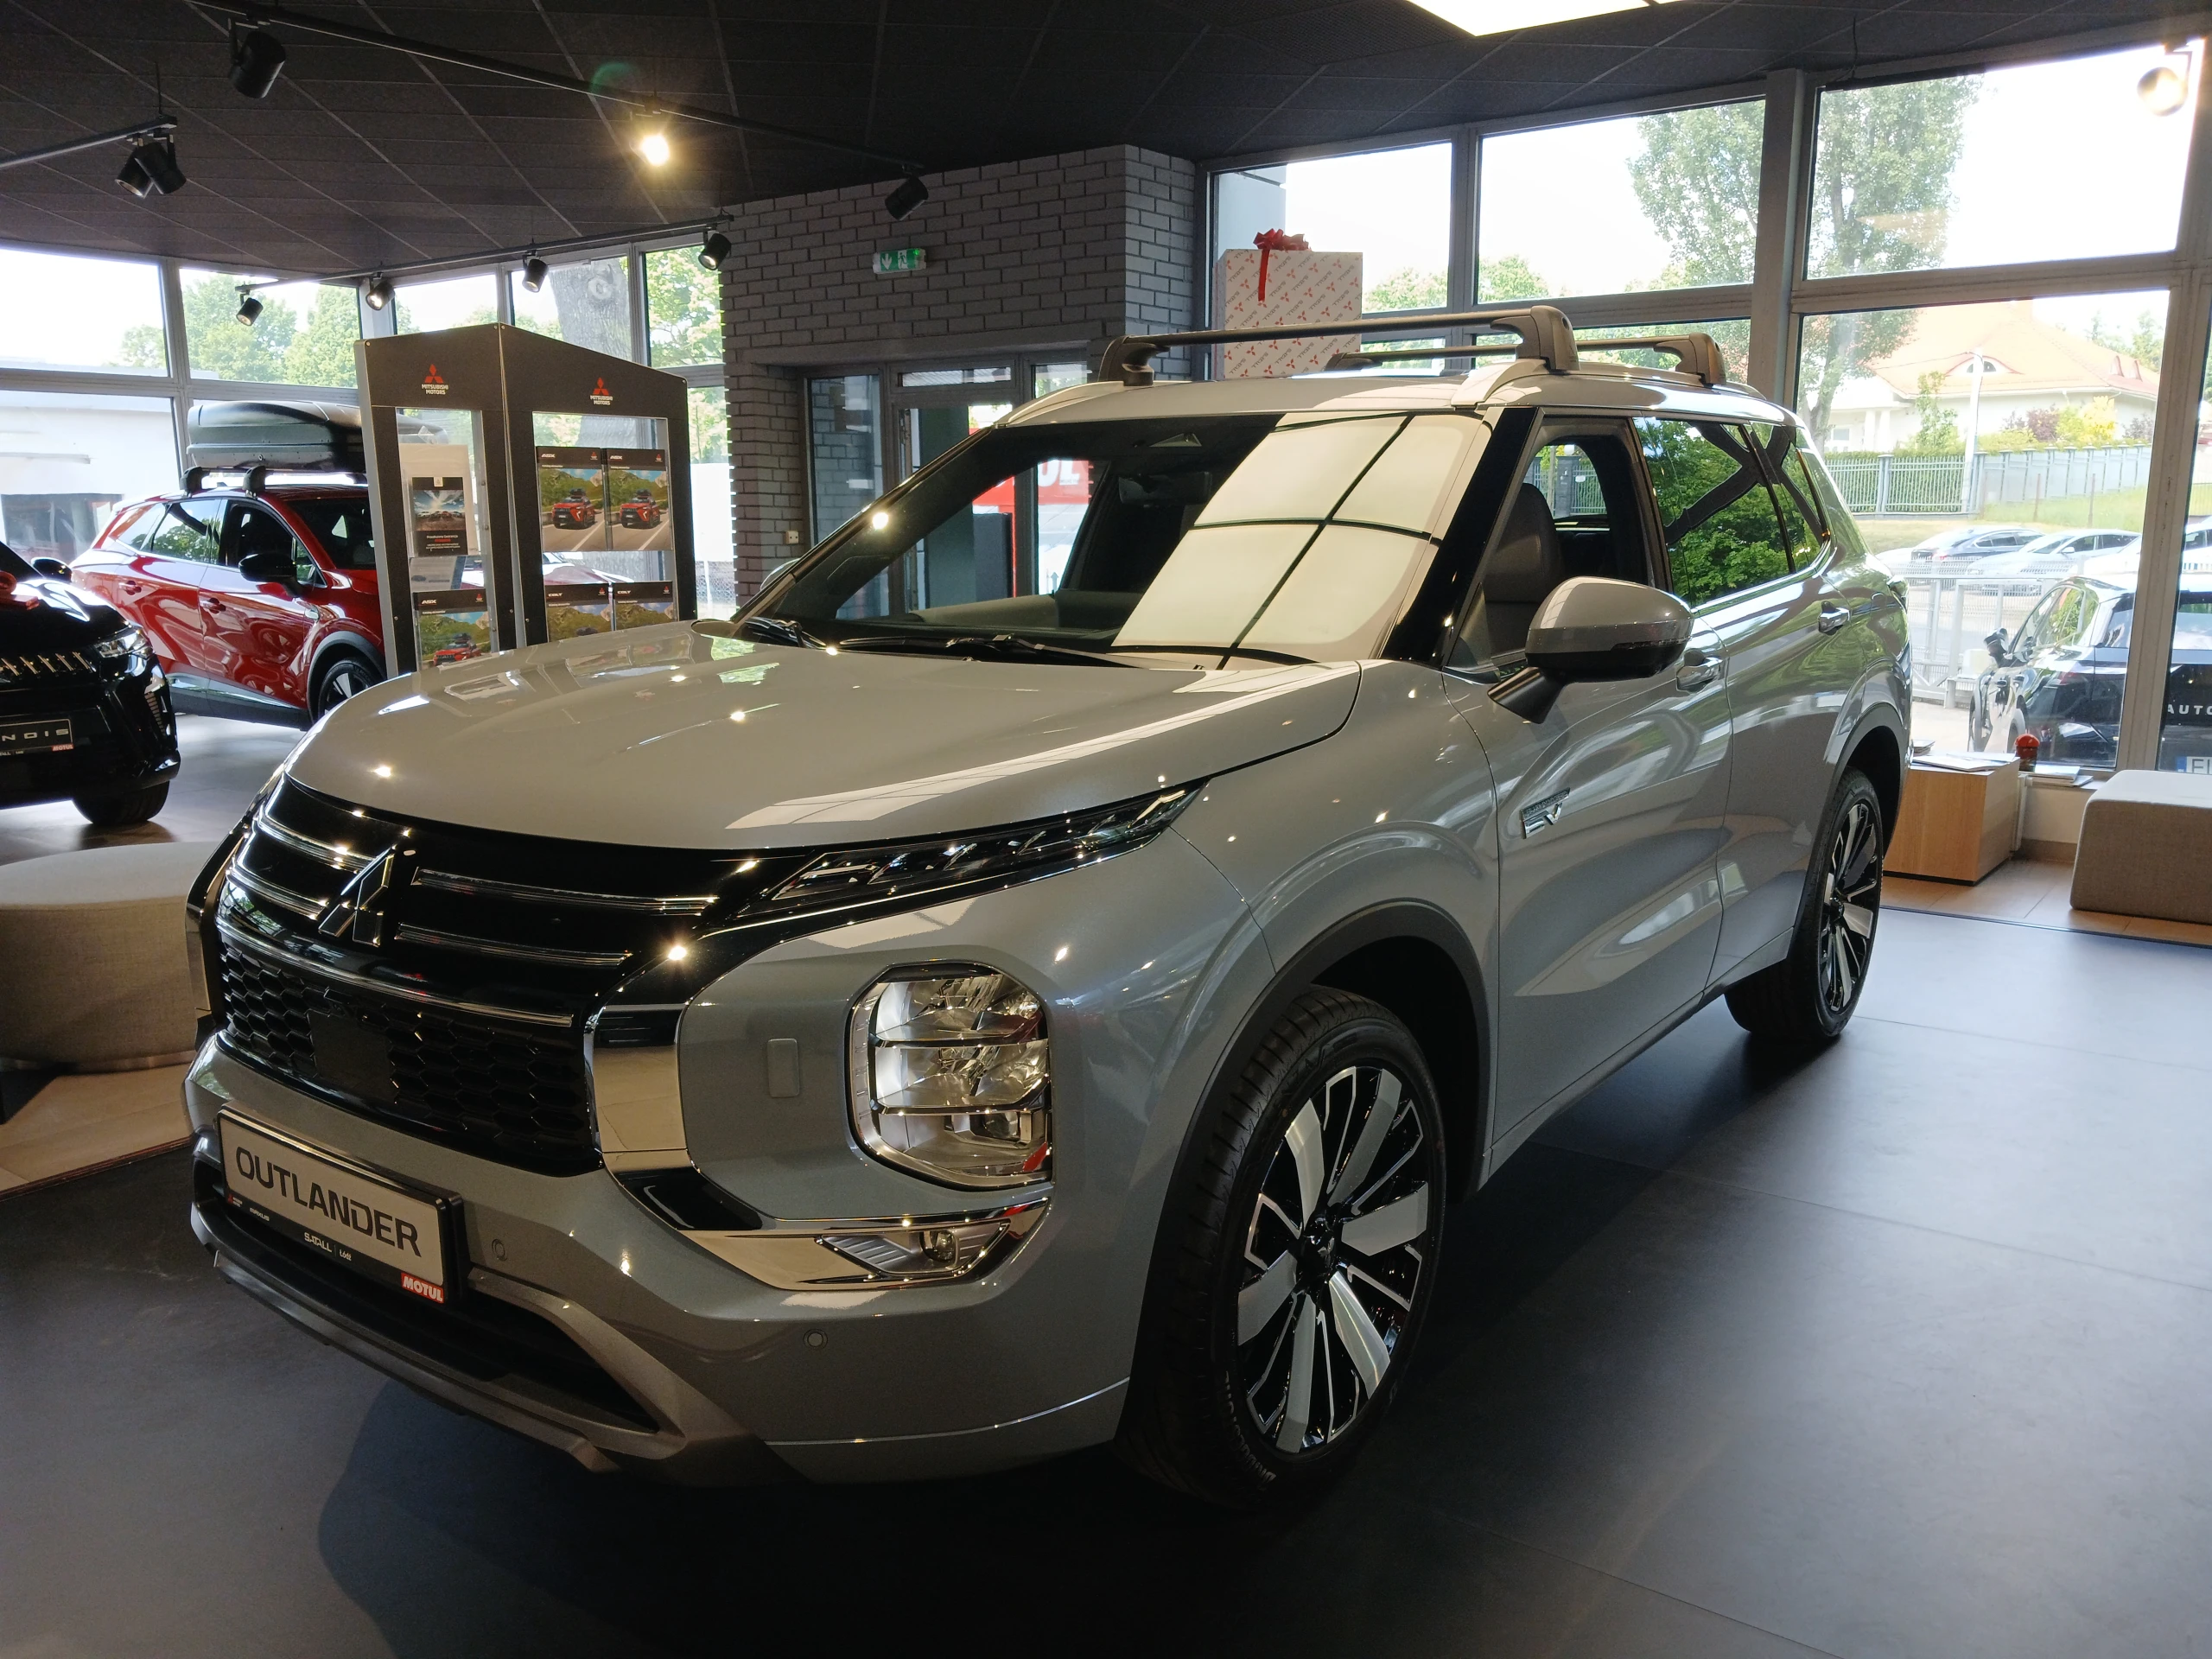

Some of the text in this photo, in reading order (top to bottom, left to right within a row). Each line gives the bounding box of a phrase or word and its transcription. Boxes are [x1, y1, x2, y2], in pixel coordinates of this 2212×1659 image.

[235, 1146, 422, 1257] OUTLANDER
[304, 1231, 333, 1253] SATALL
[403, 1275, 443, 1302] MOTUL
